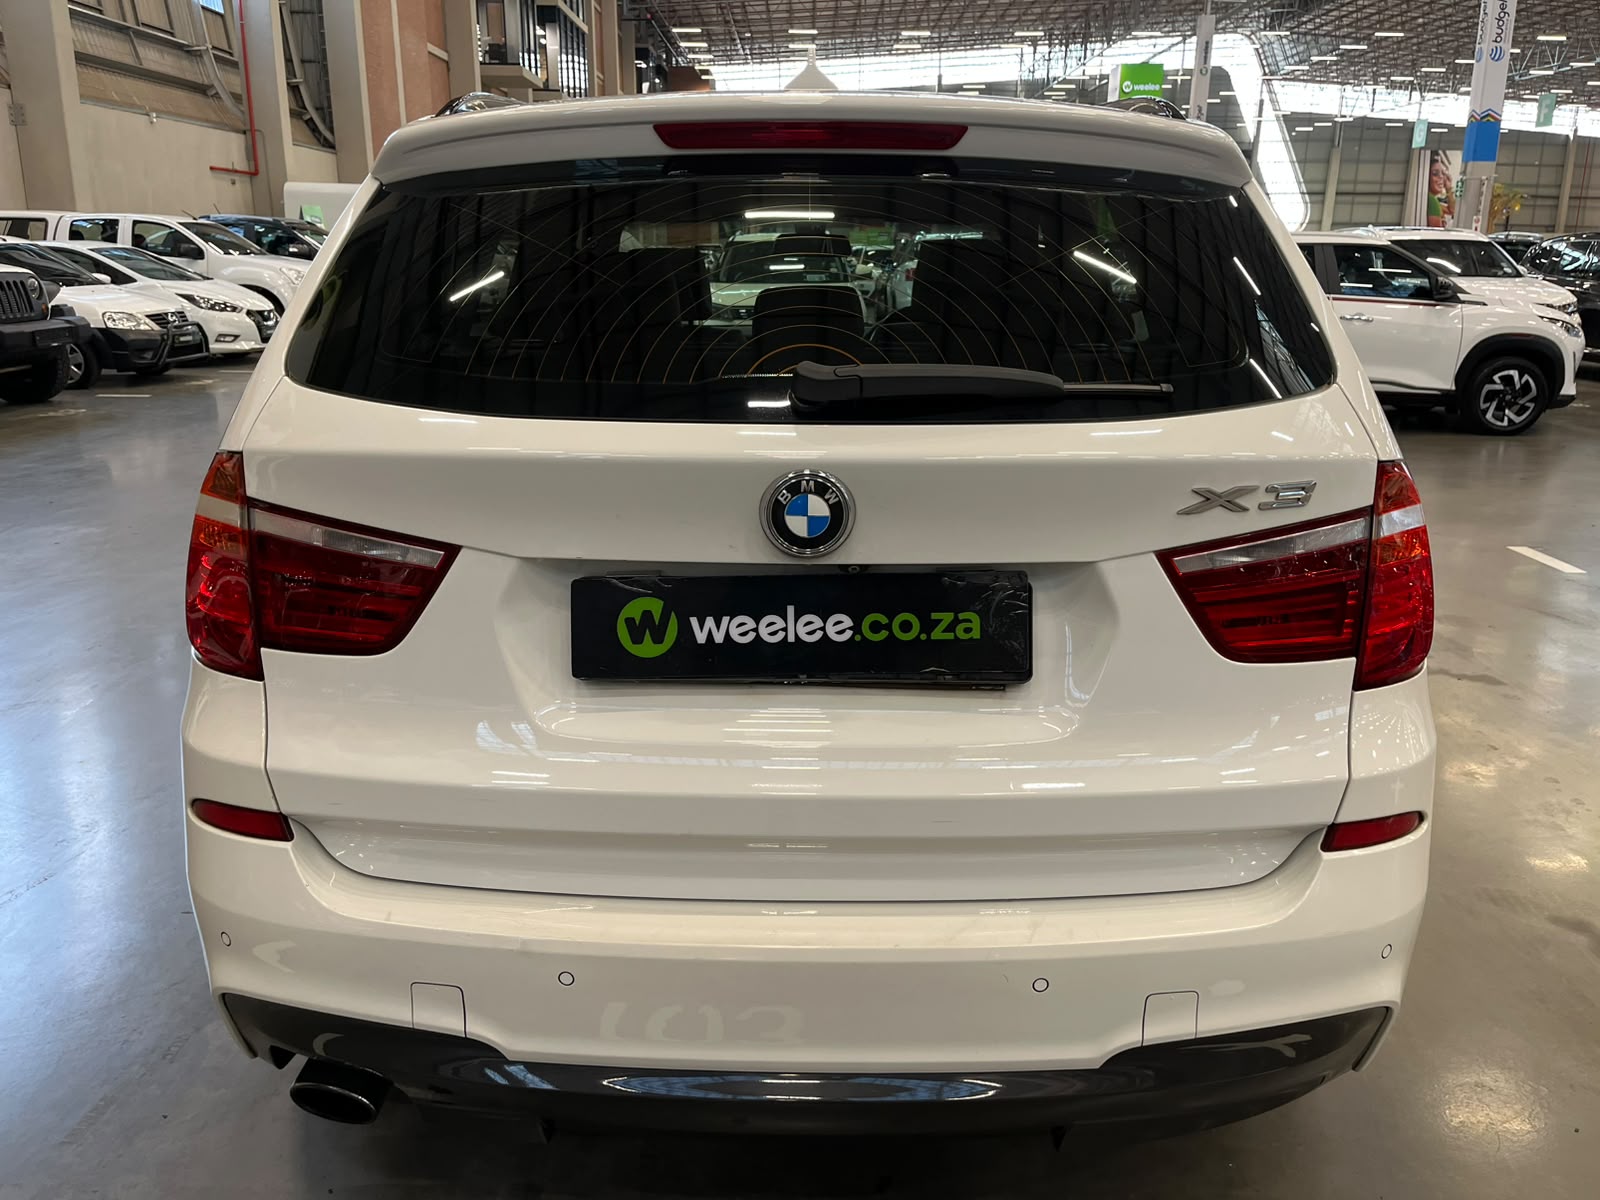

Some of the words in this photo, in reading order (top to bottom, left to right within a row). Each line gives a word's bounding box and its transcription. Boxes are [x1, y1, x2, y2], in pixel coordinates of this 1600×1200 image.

[777, 480, 839, 505] BMW
[1176, 480, 1317, 515] X3
[689, 604, 981, 644] weelee.co.za
